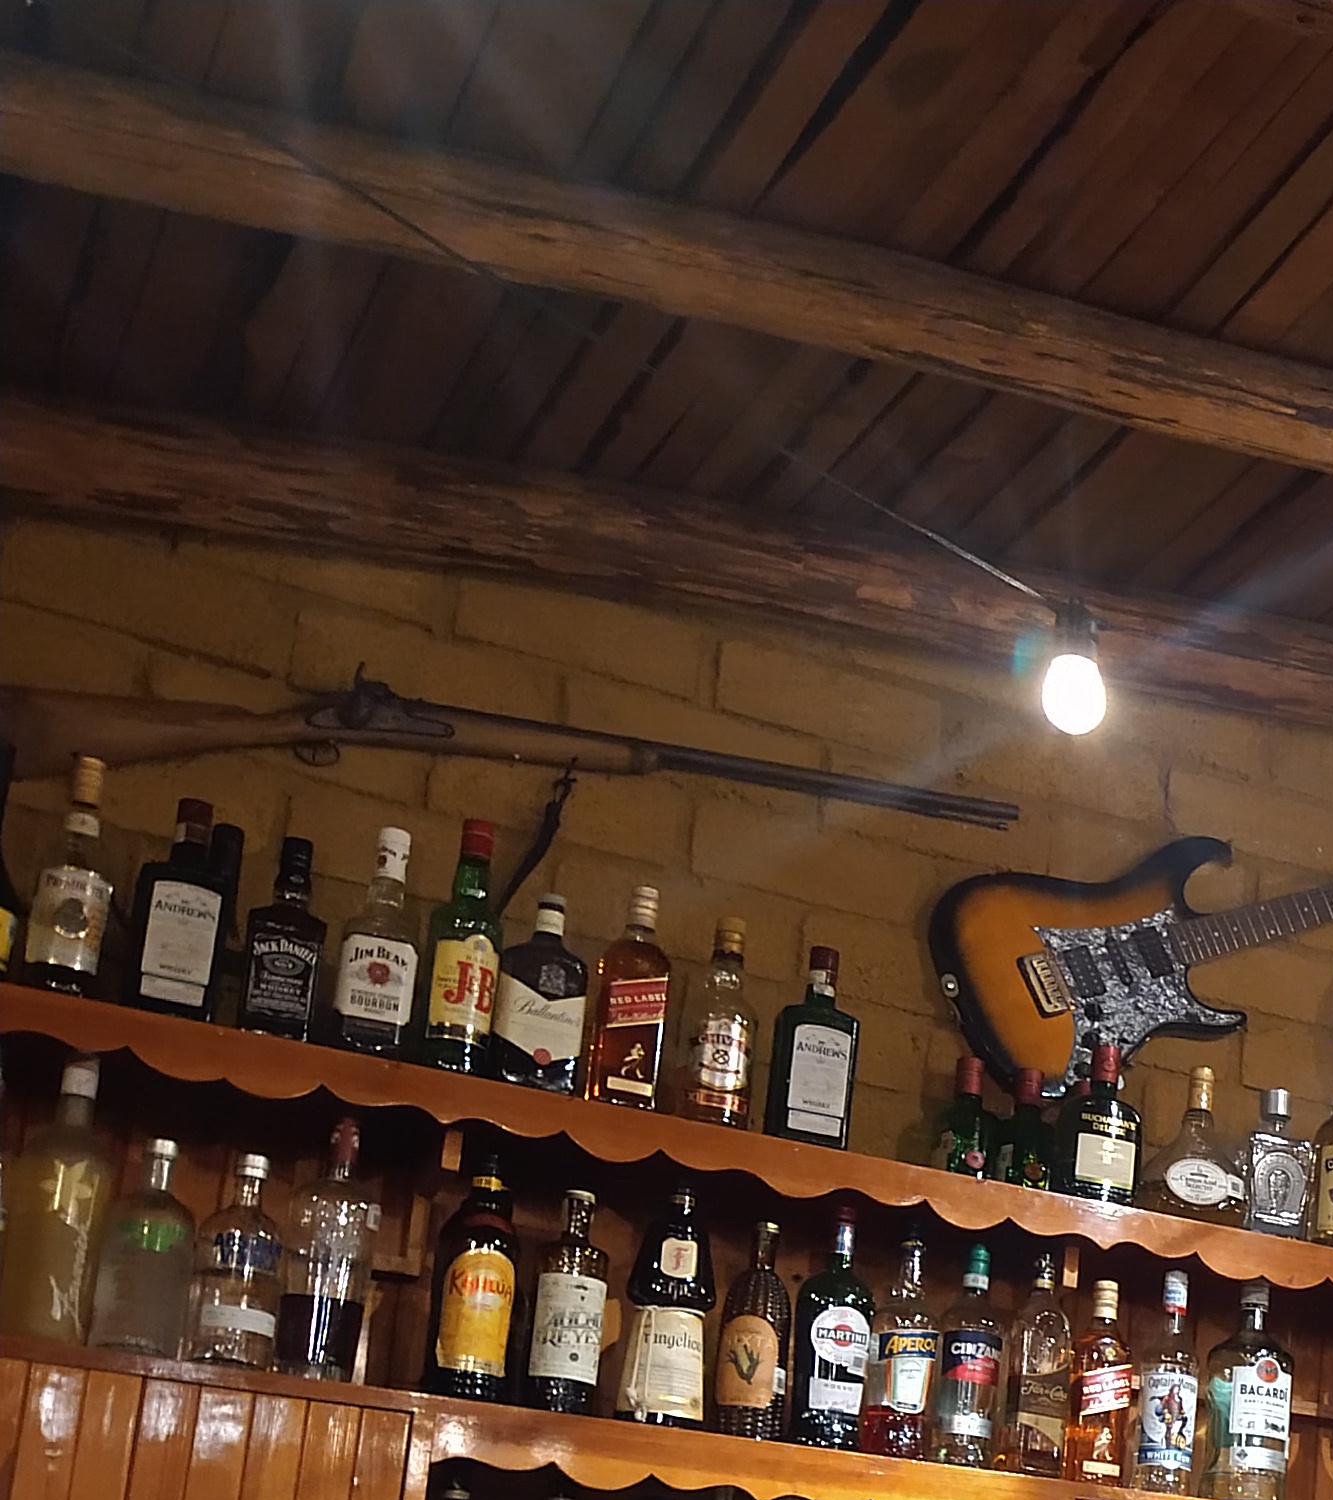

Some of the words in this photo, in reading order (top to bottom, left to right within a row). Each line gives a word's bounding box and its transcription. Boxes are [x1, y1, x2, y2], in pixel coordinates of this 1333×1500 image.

[349, 946, 375, 963] JIM
[350, 993, 400, 1012] BOURBON
[610, 996, 632, 1005] RED
[634, 993, 667, 1003] LABEL
[816, 1328, 868, 1344] MARTINI
